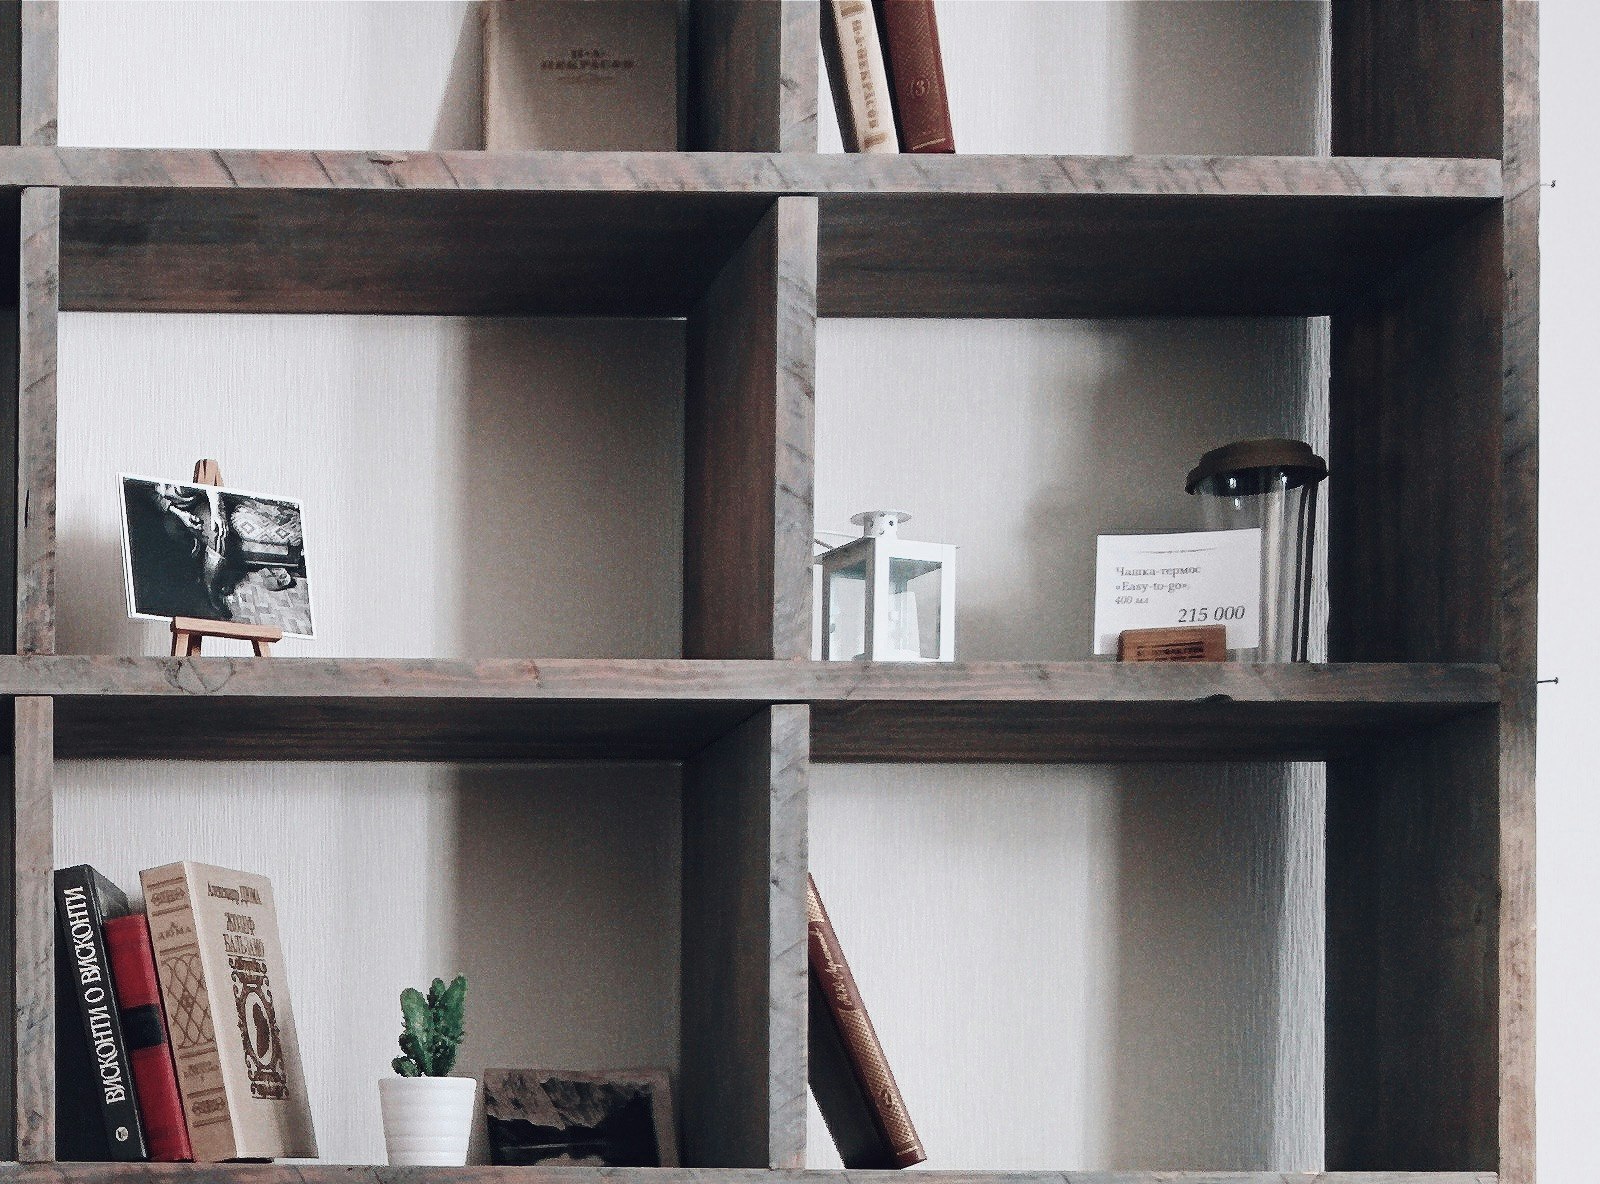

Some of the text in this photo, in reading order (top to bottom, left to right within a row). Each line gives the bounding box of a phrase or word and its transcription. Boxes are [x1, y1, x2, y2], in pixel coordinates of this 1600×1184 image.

[1116, 566, 1201, 579] Чашка-термос
[1178, 605, 1246, 623] 215 000
[64, 886, 126, 1104] ВИСКОНТИ О ВИСКОНТИ
